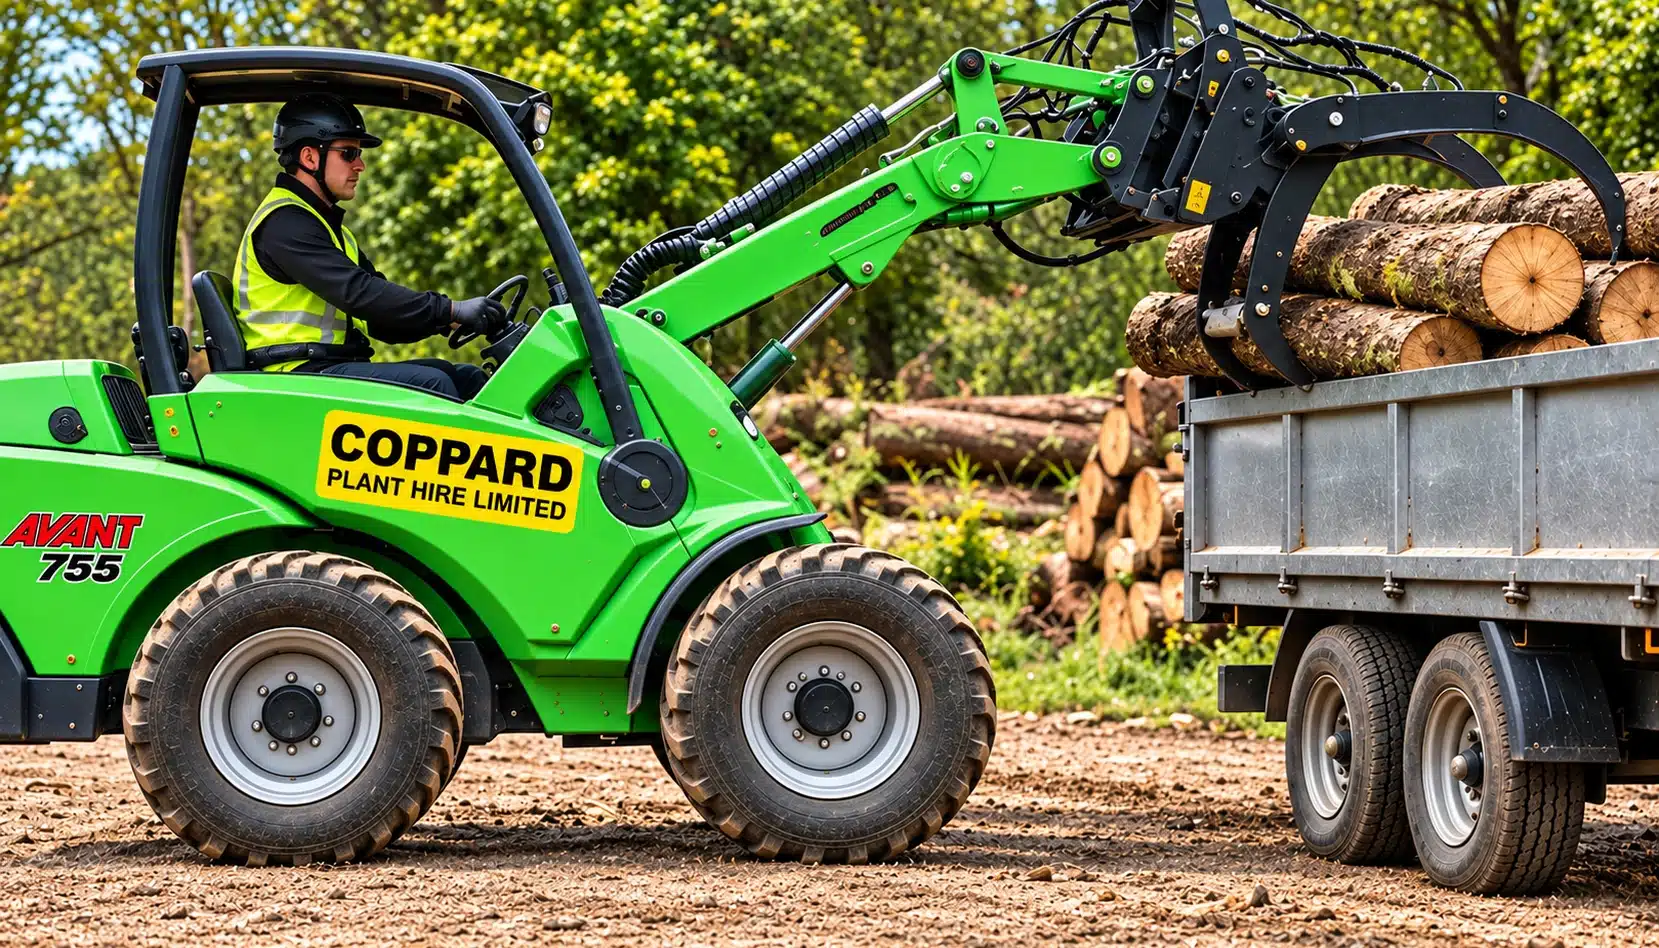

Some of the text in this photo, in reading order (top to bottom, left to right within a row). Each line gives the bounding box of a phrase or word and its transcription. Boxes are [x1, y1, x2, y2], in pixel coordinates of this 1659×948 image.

[331, 423, 573, 492] COPPARD
[327, 468, 567, 520] PLANT HIRE LIMITED
[0, 512, 144, 549] AVANT
[38, 552, 125, 584] 755
